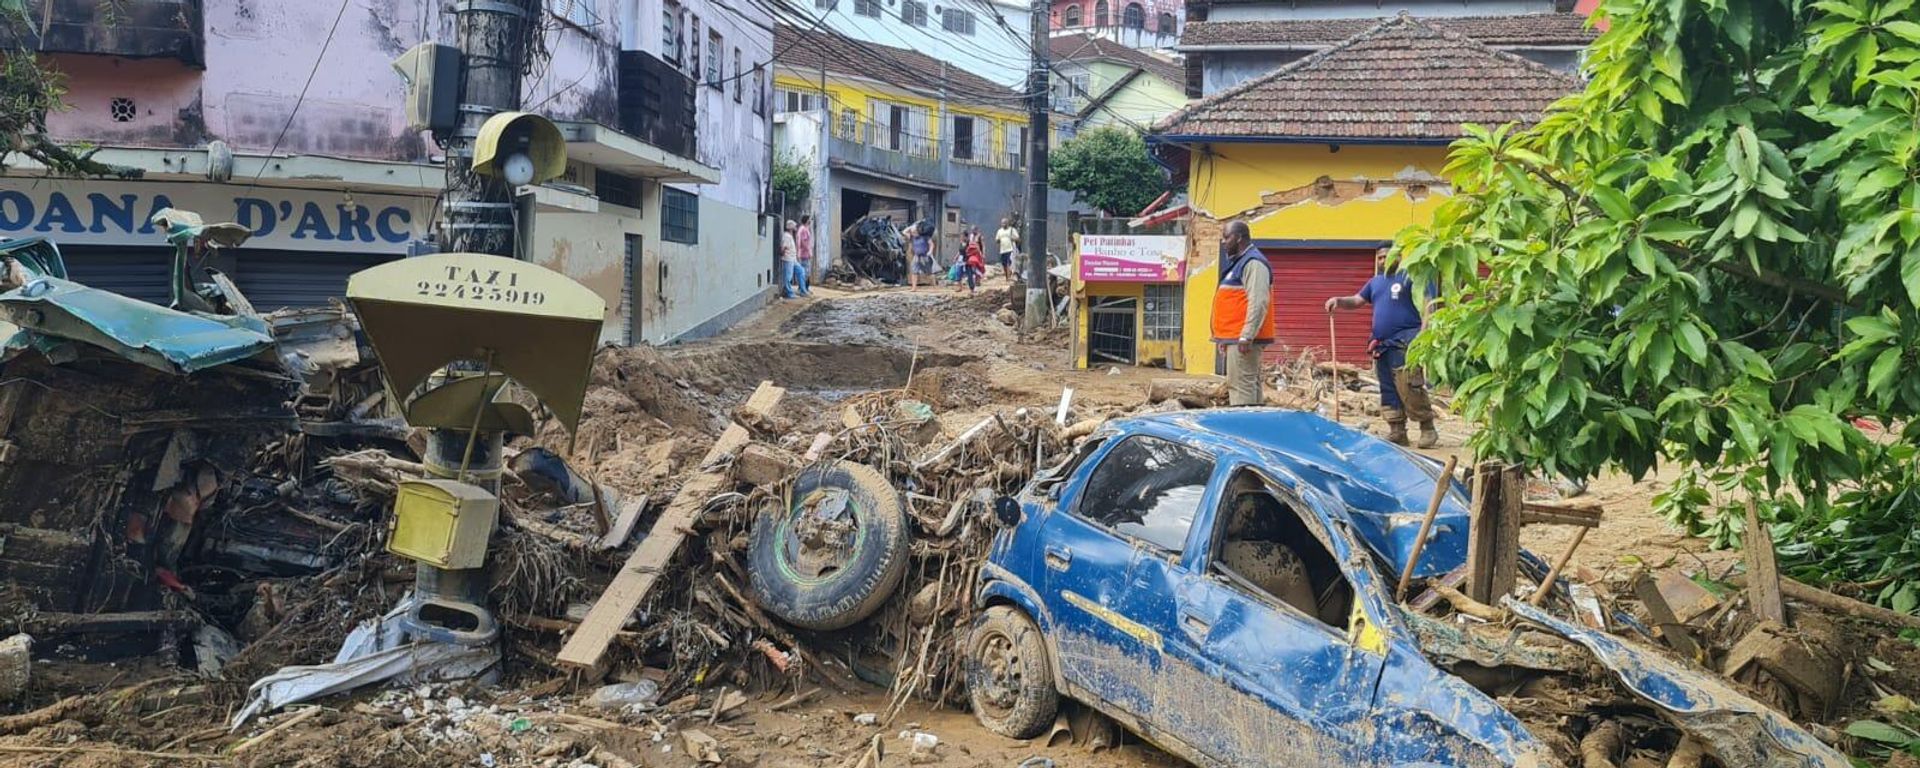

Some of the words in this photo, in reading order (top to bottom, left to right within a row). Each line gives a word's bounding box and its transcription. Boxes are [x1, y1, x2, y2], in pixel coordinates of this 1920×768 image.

[234, 197, 411, 243] D'ARC
[445, 266, 517, 286] TAXI
[417, 281, 545, 305] 22425919
